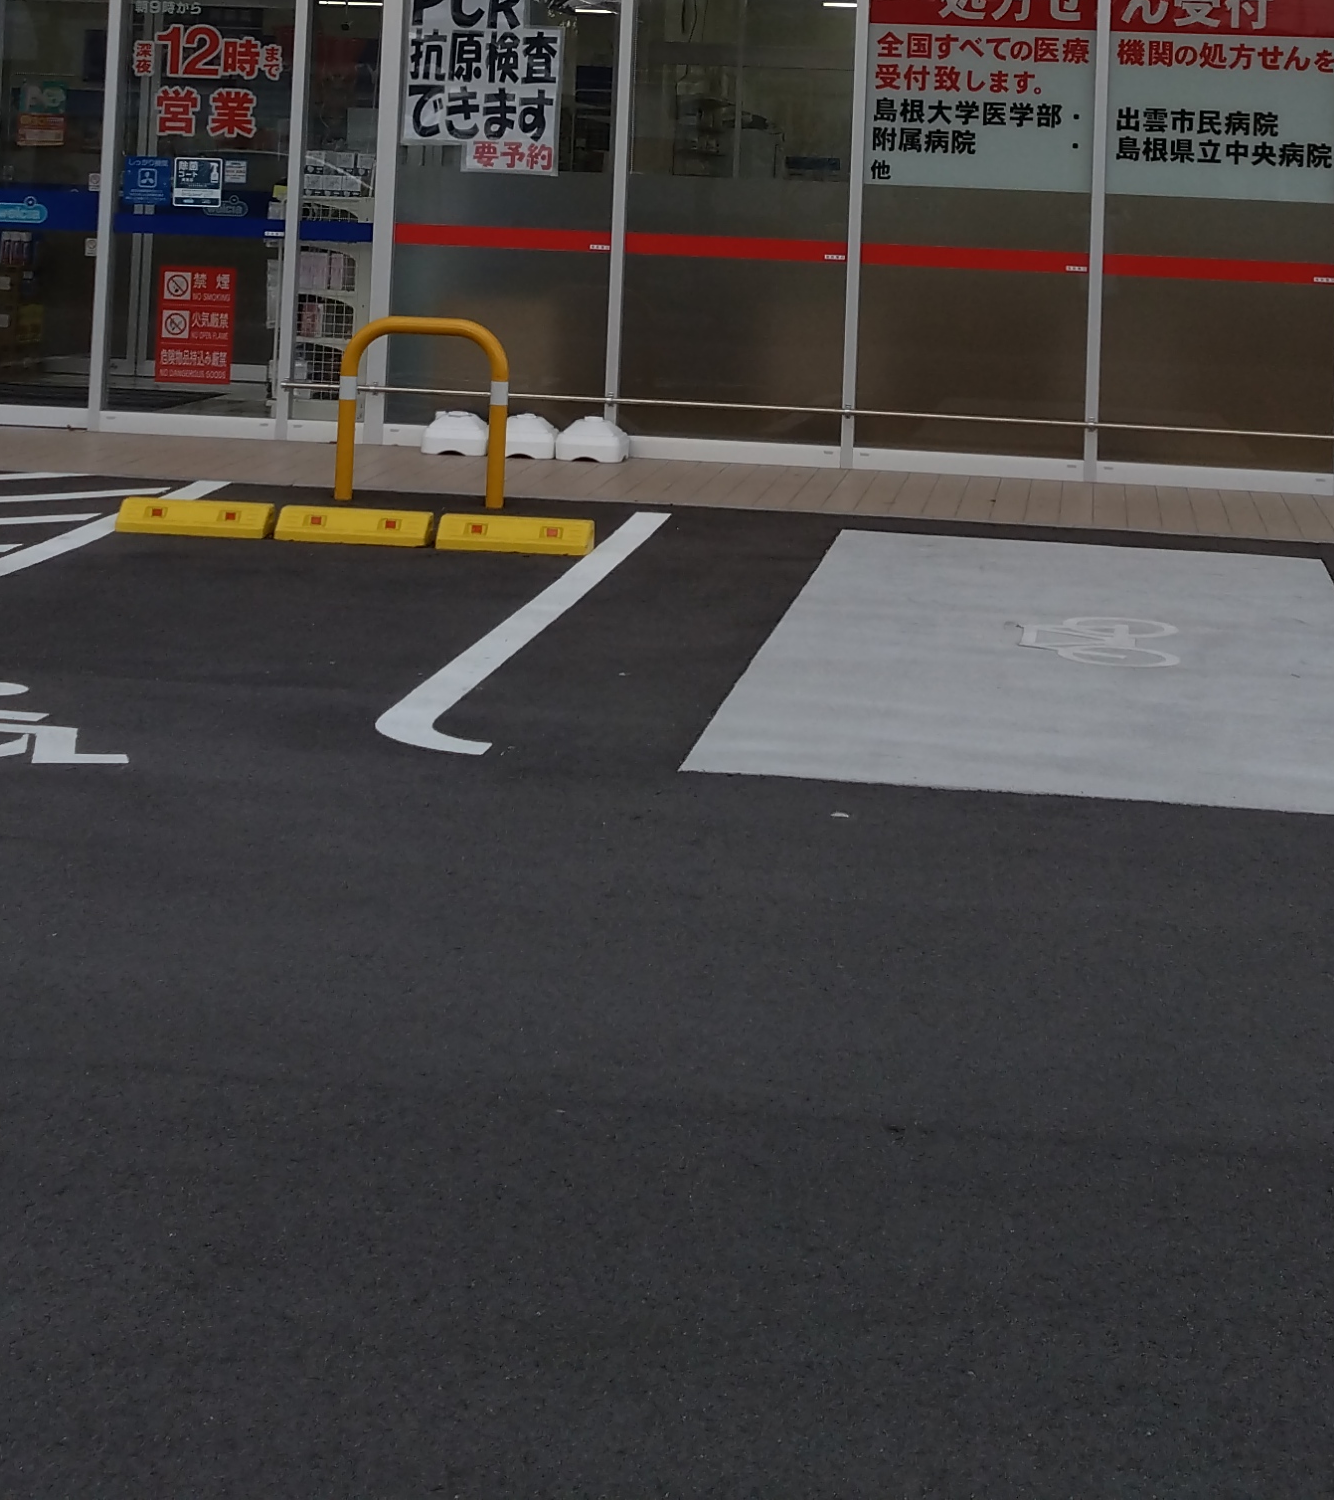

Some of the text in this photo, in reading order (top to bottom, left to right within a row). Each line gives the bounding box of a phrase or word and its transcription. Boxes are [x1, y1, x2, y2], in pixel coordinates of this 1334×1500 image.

[134, 0, 203, 15] 朝9時から
[134, 40, 155, 77] 深夜
[156, 23, 261, 80] 12時
[262, 44, 283, 81] まで
[409, 28, 559, 85] 抗原検査
[874, 62, 1044, 96] 受付致します。
[155, 85, 257, 138] 営業
[407, 83, 555, 142] できます
[872, 97, 1063, 128] 島根大学医学部
[1115, 106, 1280, 138] 出雲市民病院
[472, 140, 554, 171] 要予約
[871, 126, 977, 156] 附属病院
[1115, 135, 1334, 169] 島根県立中央病院
[870, 158, 893, 181] 他
[193, 272, 231, 290] 禁煙
[203, 293, 231, 303] SMOKING
[191, 311, 229, 329] 火気厳禁
